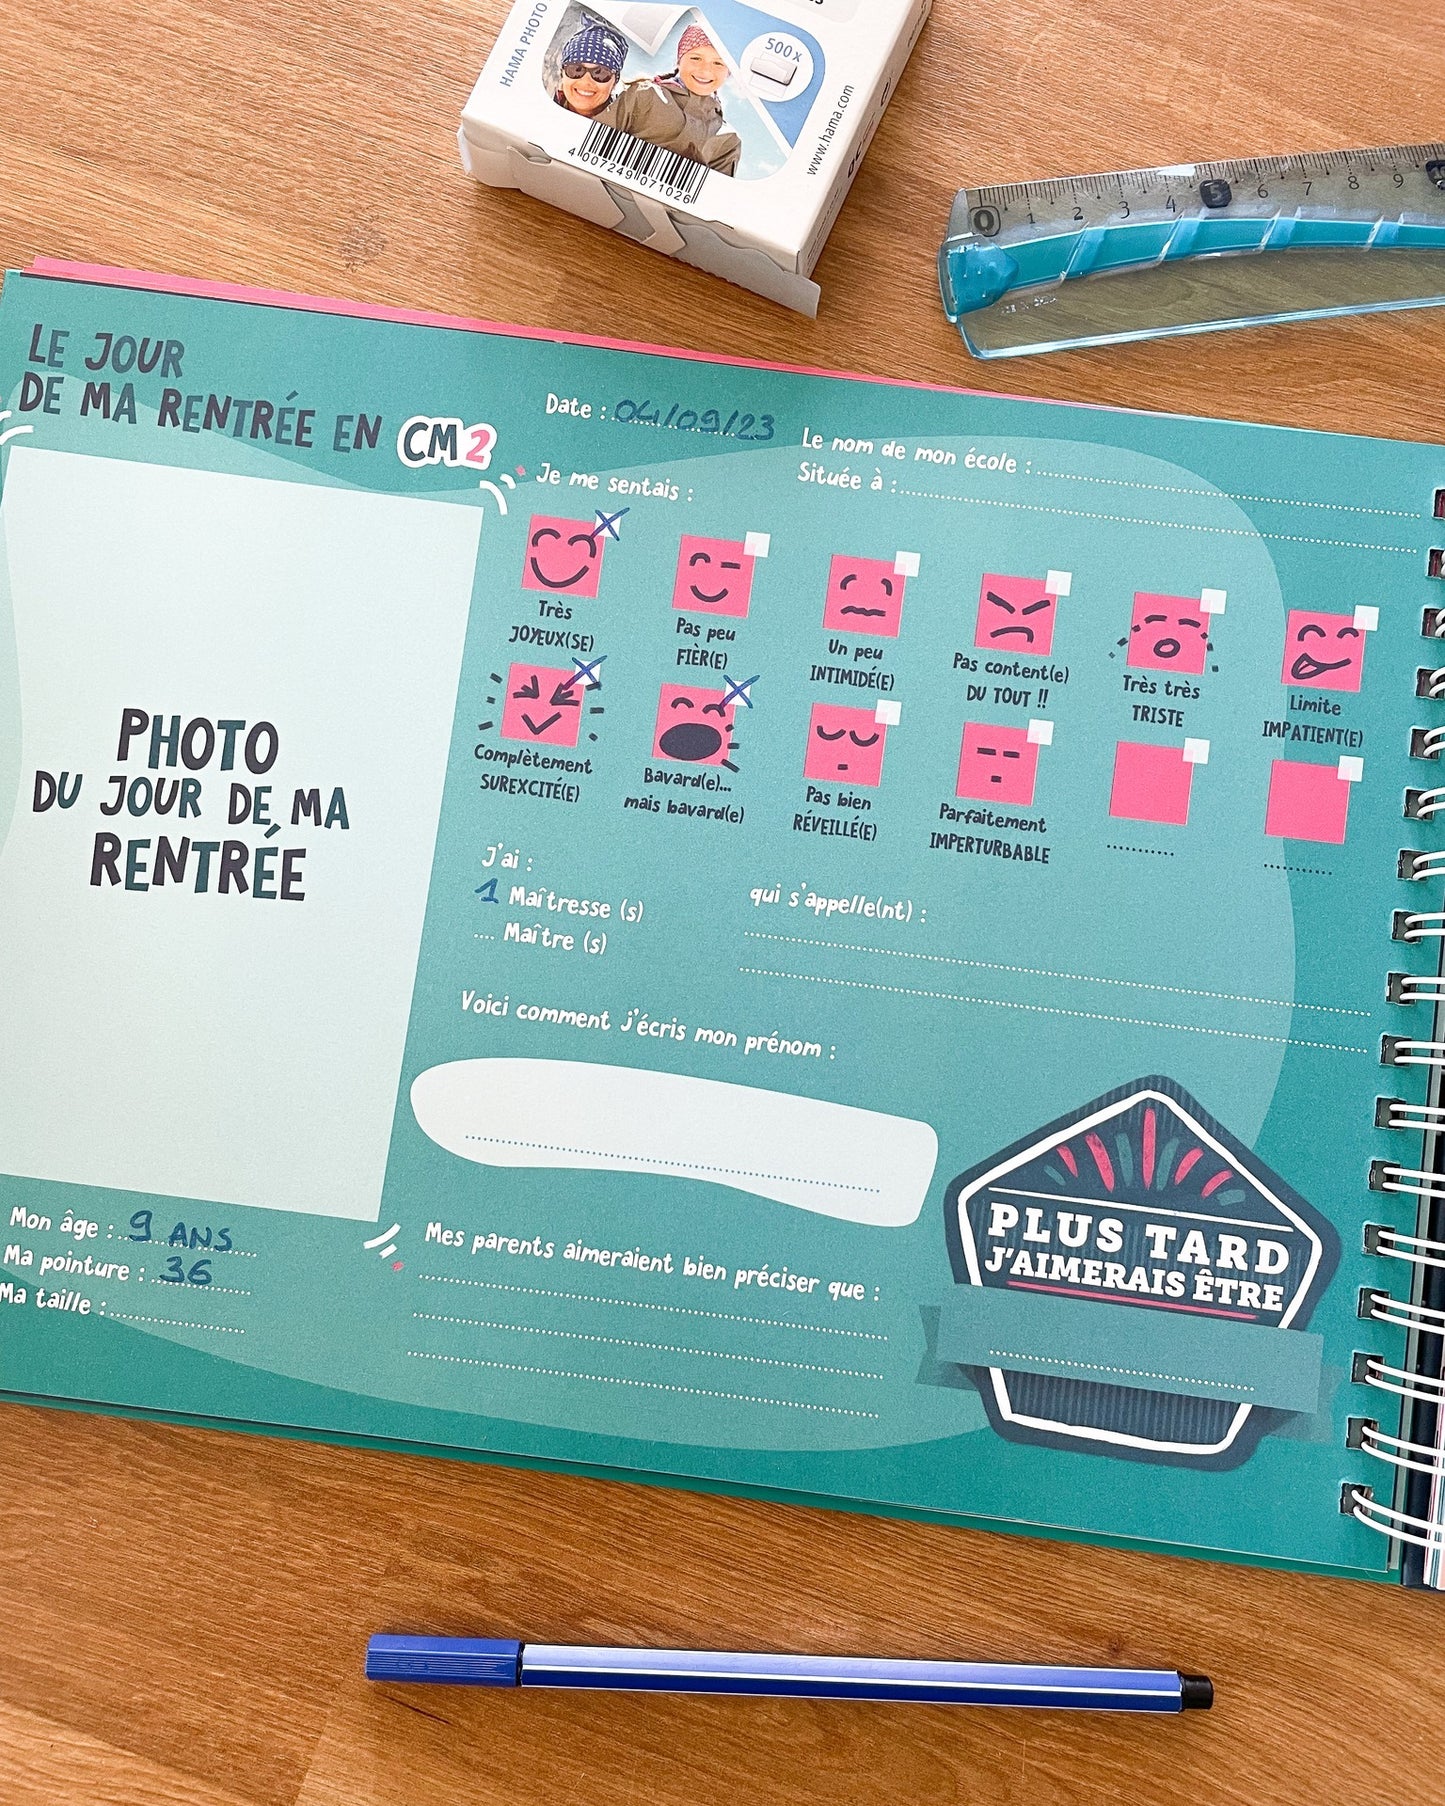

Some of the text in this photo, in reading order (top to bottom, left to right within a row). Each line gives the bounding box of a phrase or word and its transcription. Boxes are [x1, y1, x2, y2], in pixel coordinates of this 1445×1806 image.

[500, 2, 548, 87] HAMA PHOTO
[807, 84, 854, 175] www.hama.com
[973, 209, 995, 237] 0
[1027, 212, 1036, 224] 1
[1072, 206, 1083, 221] 2
[1118, 201, 1130, 219] 3
[1165, 195, 1177, 213] 4
[1257, 183, 1269, 199] 6
[1302, 181, 1313, 196] 7
[1347, 175, 1360, 190] 8
[1393, 173, 1404, 188] 9
[28, 323, 185, 378] LE JOUR
[18, 371, 492, 464] DE MA RENTRÉE EN CM2
[545, 393, 592, 419] Date
[614, 400, 775, 441] 04/09/23
[802, 427, 824, 449] Le
[831, 436, 873, 455] nom
[881, 440, 906, 460] de
[914, 446, 956, 465] mon
[964, 447, 1017, 474] école
[536, 462, 561, 485] Je
[569, 471, 599, 490] me
[607, 474, 680, 501] sentais
[797, 461, 862, 490] Située
[870, 467, 883, 491] à
[538, 599, 573, 620] Très
[508, 624, 595, 653] JOYEUX(SE)
[676, 617, 736, 643] Pas peu
[676, 643, 728, 671] FIÈR(E)
[828, 638, 883, 662] Un peu
[809, 664, 895, 692] INTIMIDÉ(E)
[952, 652, 1070, 685] Pas content(e)
[966, 685, 987, 702] DU
[993, 687, 1032, 708] TOUT
[1122, 674, 1201, 700] Très très
[1132, 704, 1185, 728] TRISTE
[1290, 694, 1342, 716] Limite
[116, 707, 279, 775] PHOTO
[1261, 720, 1364, 748] IMPATIENT(E)
[474, 743, 593, 775] Complètement
[32, 770, 350, 830] DU JOUR DE MA
[479, 773, 581, 803] SUREXCITÉ(E)
[805, 785, 872, 811] Pas bien
[623, 795, 745, 825] mais bavard(e)
[793, 809, 878, 841] RÉVEILLÉ(E)
[939, 802, 1047, 833] Parfaitement
[90, 823, 307, 901] RENTRÉE
[481, 843, 520, 869] J'ai
[929, 832, 1051, 864] IMPERTURBABLE
[474, 877, 499, 904] 1
[509, 886, 644, 923] Maîtresse (s)
[749, 882, 781, 907] qui
[788, 882, 913, 923] s'appelle(nt)
[503, 922, 607, 955] Maître (s)
[460, 990, 509, 1017] Voici
[516, 1002, 611, 1031] comment
[620, 1007, 687, 1041] j'écris
[693, 1026, 737, 1048] mon
[743, 1032, 822, 1058] prénom
[10, 1206, 52, 1231] Mon
[59, 1209, 99, 1240] âge
[128, 1210, 233, 1251] 9 ANS
[987, 1202, 1291, 1276] PLUS TARD
[3, 1244, 34, 1266] Ma
[39, 1250, 130, 1281] pointure
[158, 1256, 213, 1285] 36
[425, 1222, 464, 1247] Mes
[471, 1231, 555, 1259] parents
[563, 1239, 675, 1275] aimeraient
[682, 1256, 727, 1281] bien
[733, 1264, 820, 1294] préciser
[827, 1280, 866, 1301] que
[985, 1245, 1285, 1313] J'AIMERAIS ÊTRE
[0, 1282, 27, 1304] Ma
[36, 1288, 91, 1315] taille
